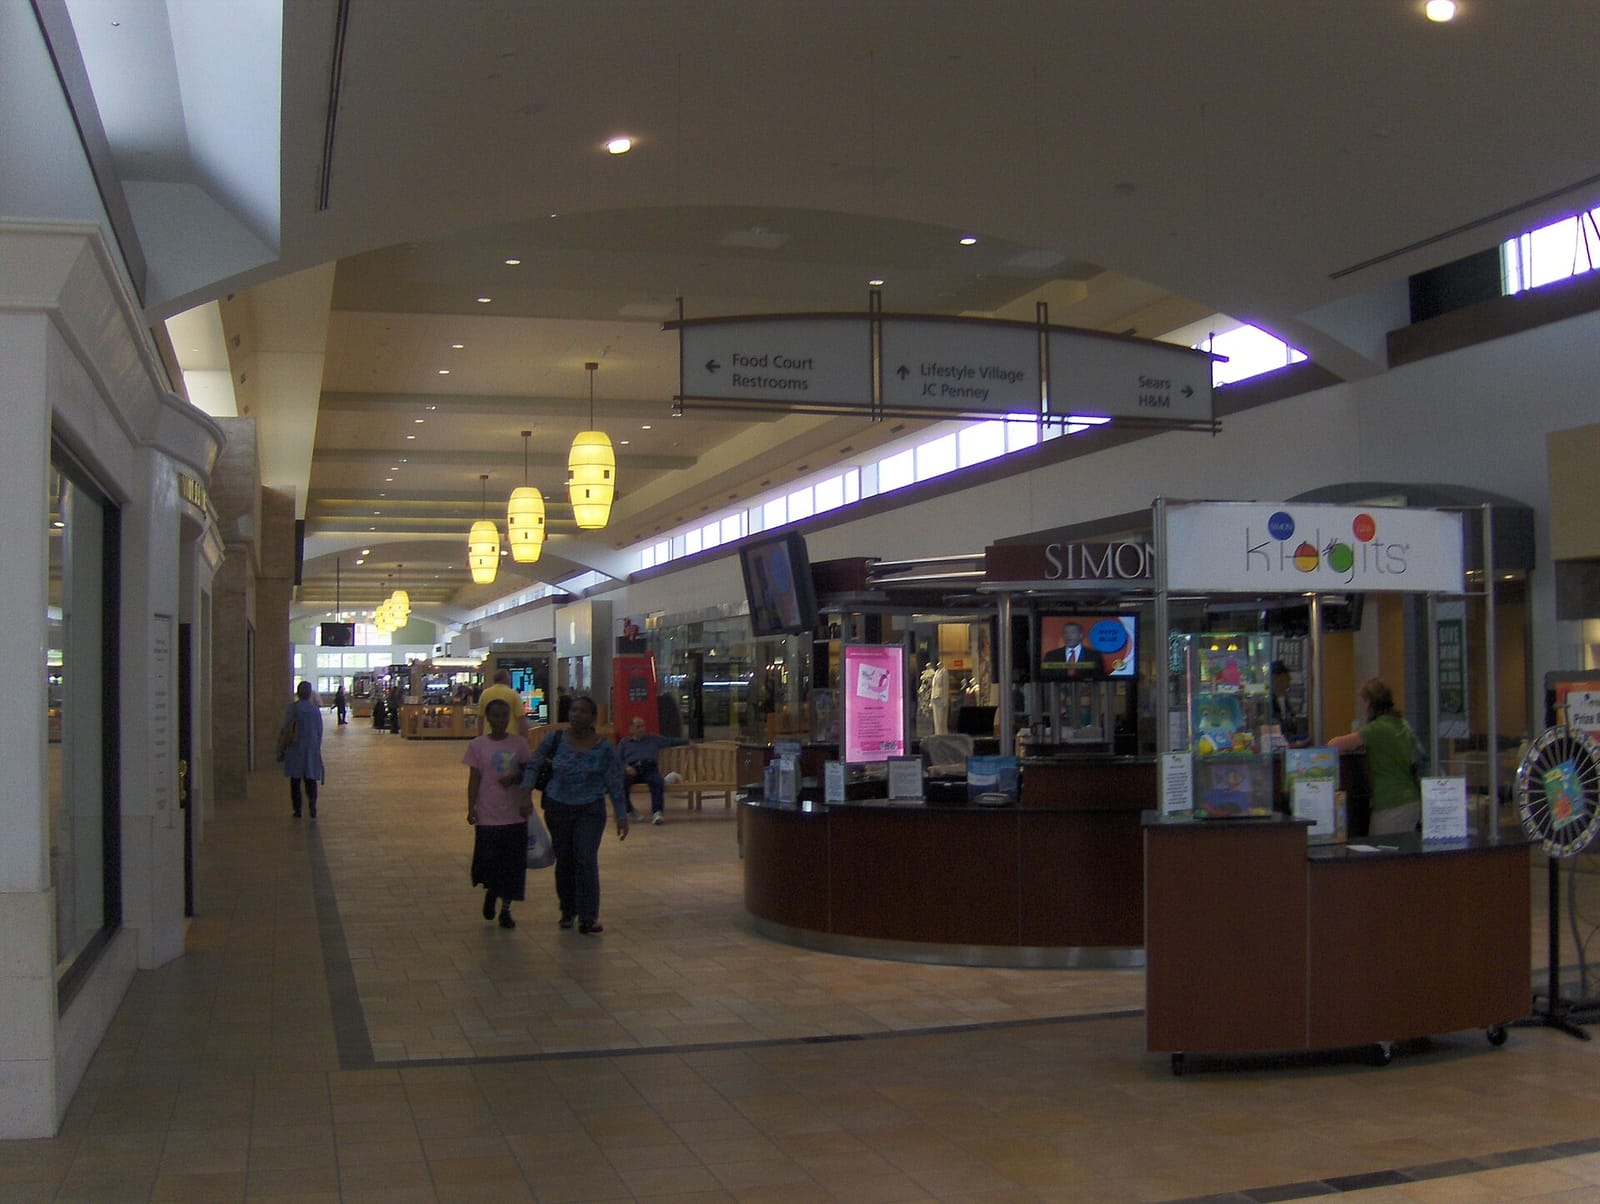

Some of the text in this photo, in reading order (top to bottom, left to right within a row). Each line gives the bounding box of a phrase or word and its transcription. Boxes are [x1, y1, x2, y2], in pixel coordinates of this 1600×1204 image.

[732, 352, 813, 370] Food Court
[732, 373, 808, 390] Restrooms
[920, 363, 1023, 384] Lifestyle Village
[1138, 375, 1171, 390] Sears
[922, 383, 990, 401] JC Penney
[1138, 393, 1170, 409] H&M
